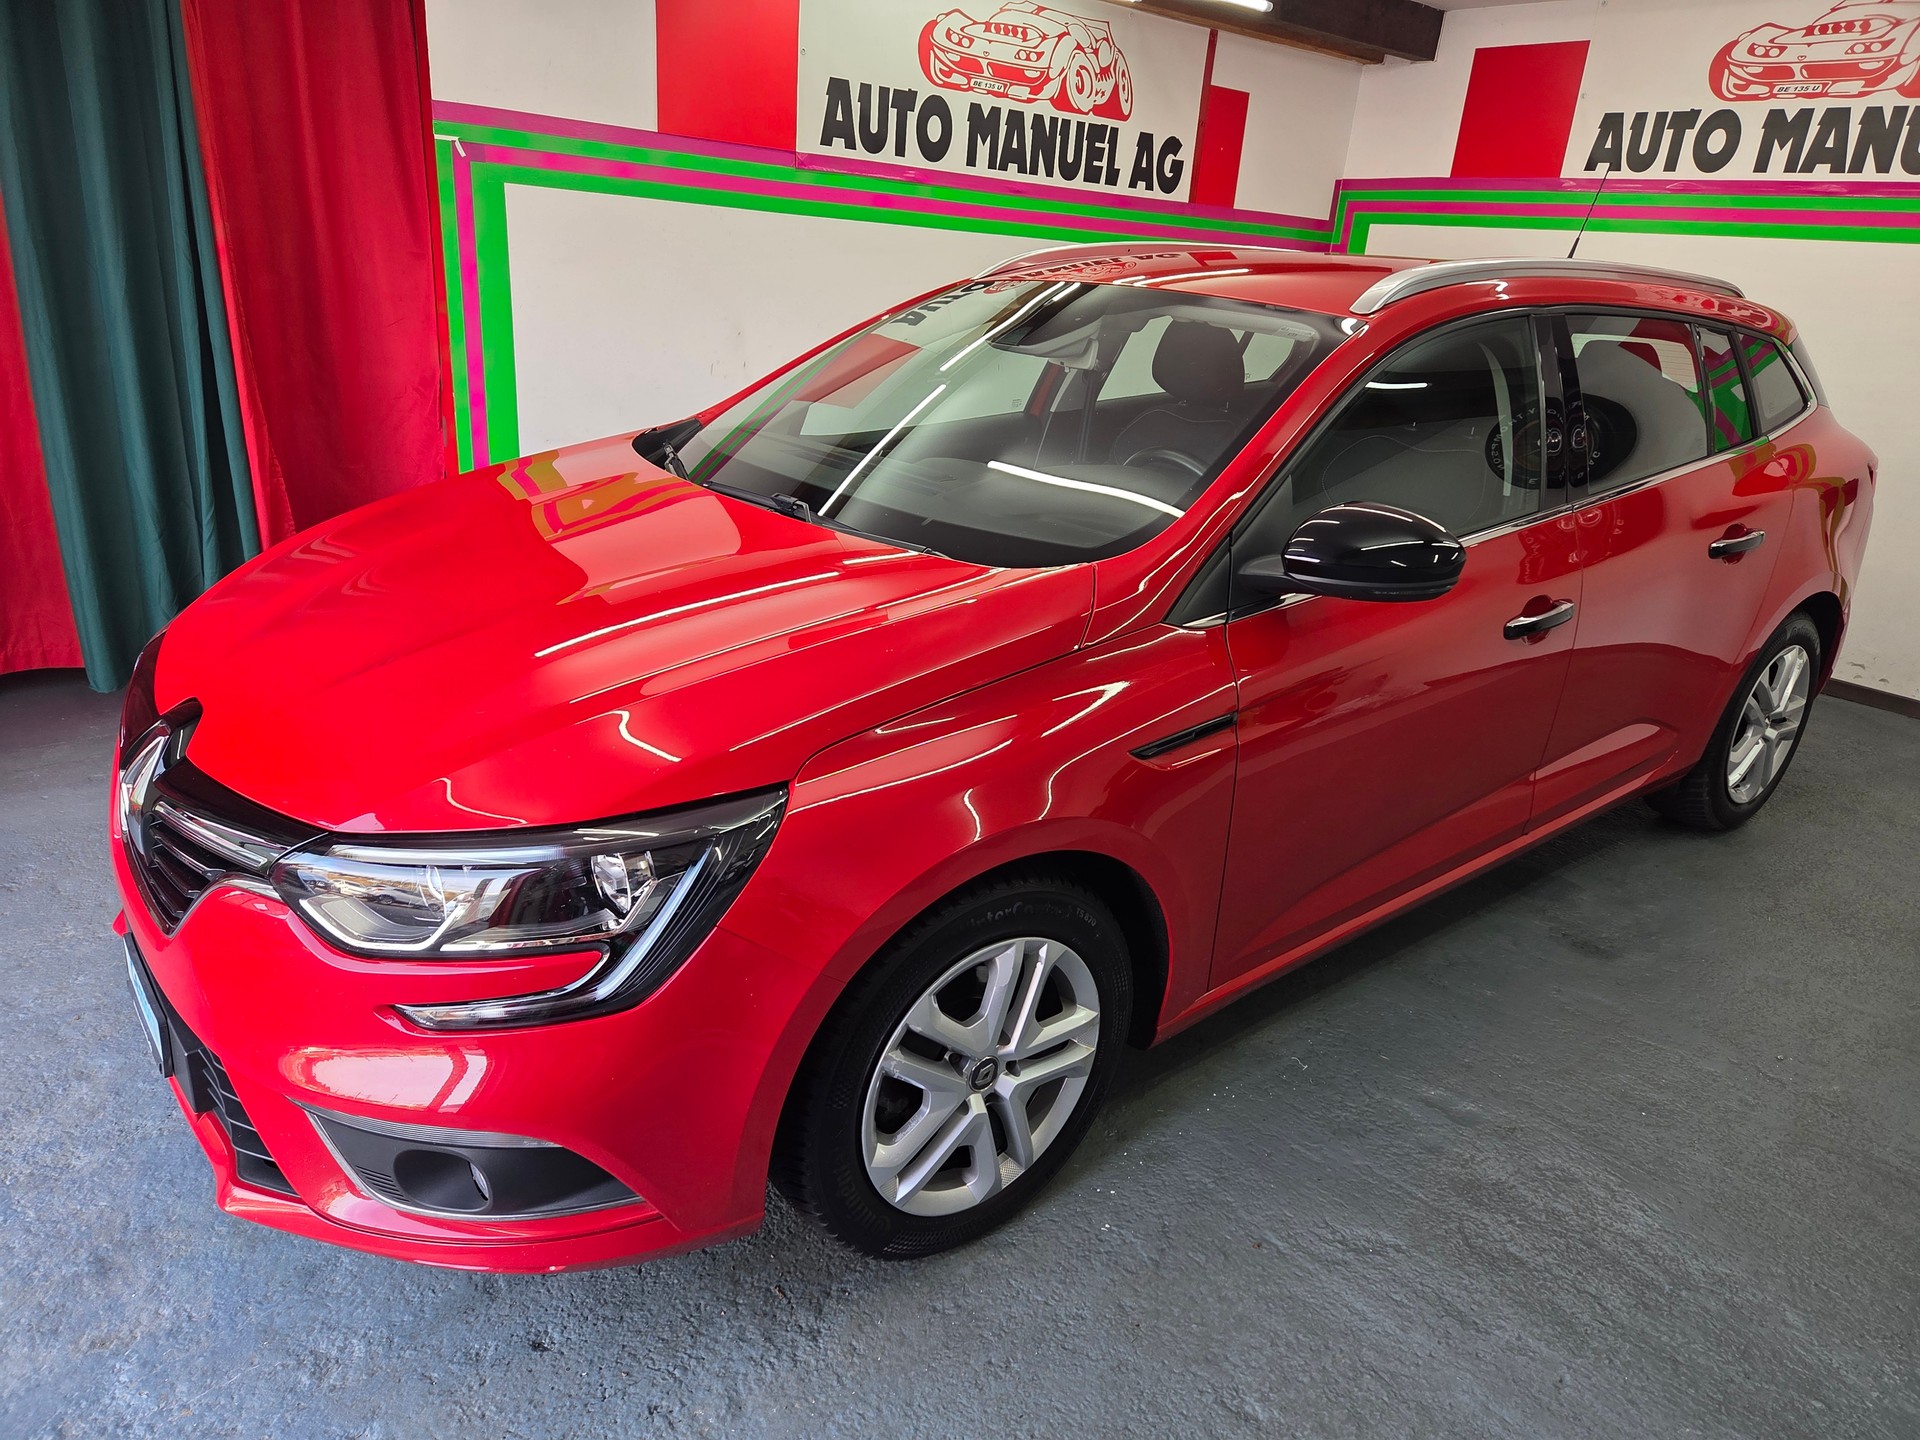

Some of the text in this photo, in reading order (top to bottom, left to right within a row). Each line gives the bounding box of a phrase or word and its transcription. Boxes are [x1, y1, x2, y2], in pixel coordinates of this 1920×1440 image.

[820, 76, 1184, 194] AUTO MANUEL AG
[1584, 108, 1742, 173] AUTO
